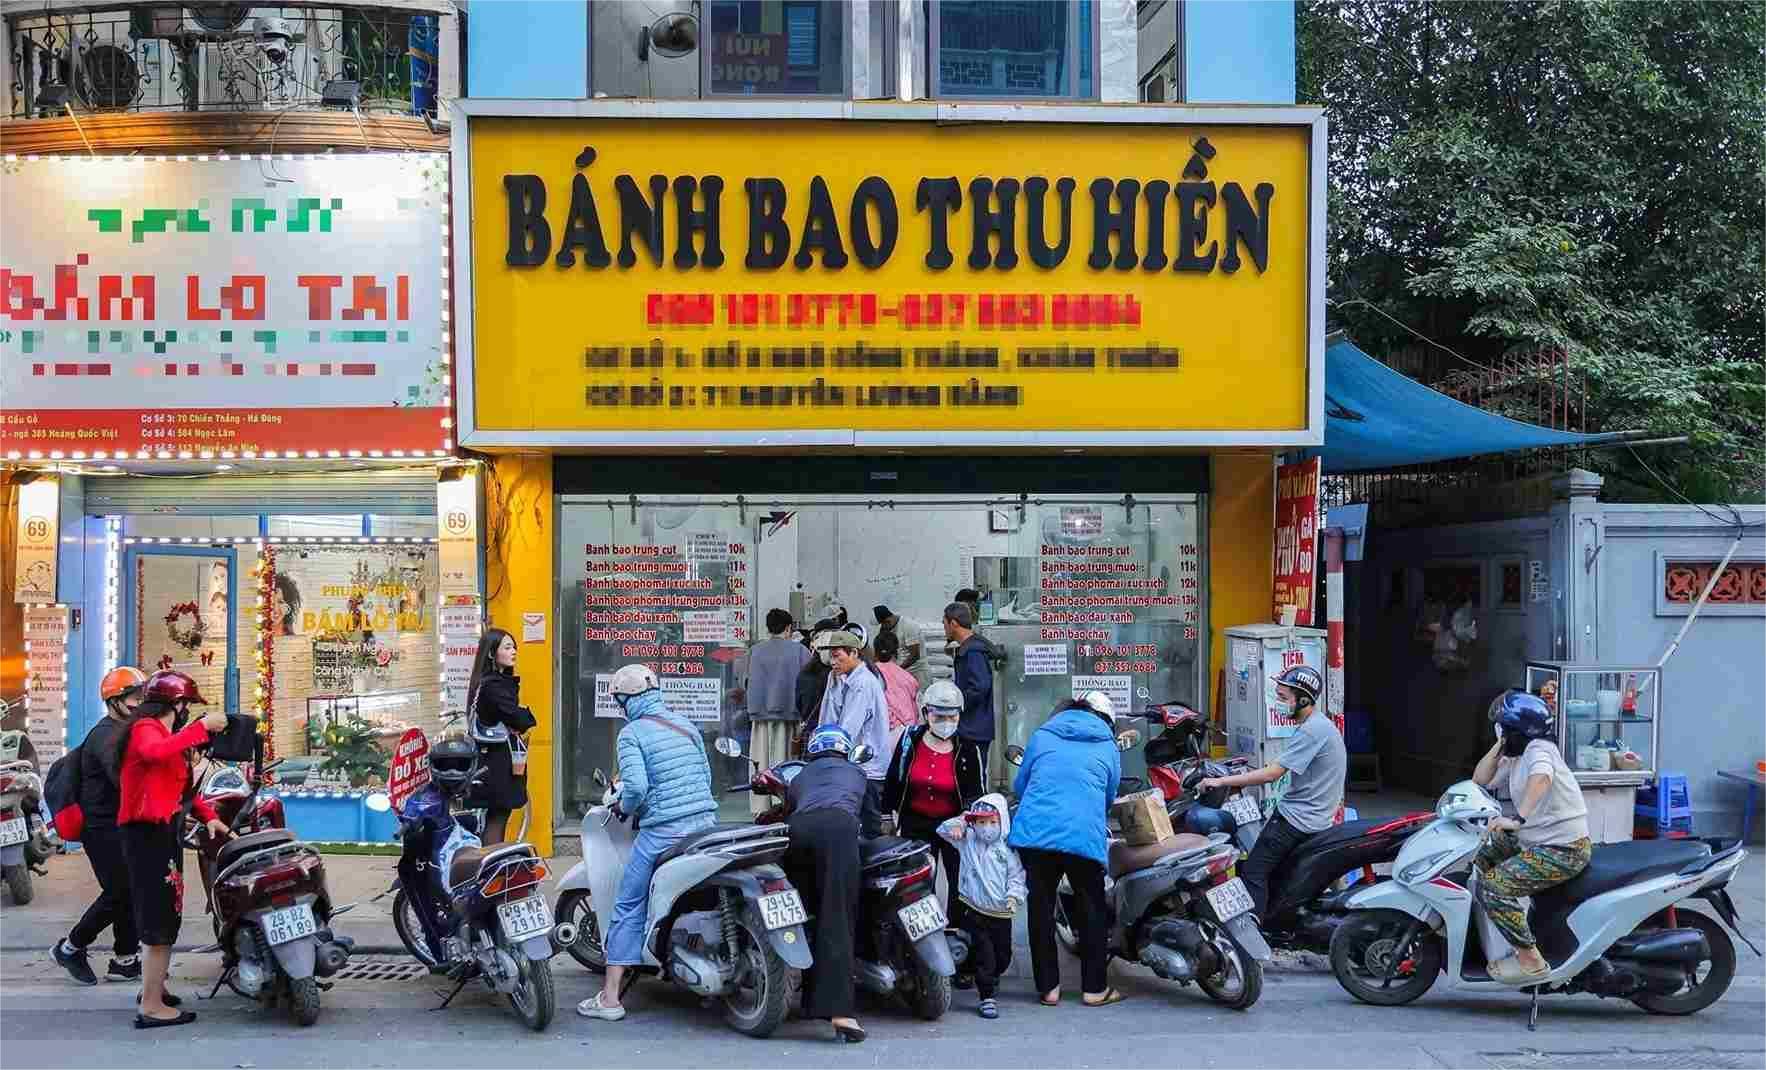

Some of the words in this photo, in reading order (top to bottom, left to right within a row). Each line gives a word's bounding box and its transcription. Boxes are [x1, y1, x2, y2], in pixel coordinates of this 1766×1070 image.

[503, 146, 724, 271] BÁNH
[744, 175, 899, 270] BAO
[915, 177, 1074, 271] THU
[1088, 137, 1275, 275] HIỀN
[447, 512, 467, 529] 69
[28, 521, 47, 537] 69
[729, 544, 745, 555] 10k
[1180, 545, 1196, 555] 10k
[735, 612, 745, 622] 7k
[734, 628, 745, 638] 3k
[661, 645, 678, 656] 101
[1095, 646, 1112, 656] 096
[1117, 646, 1132, 656] 101
